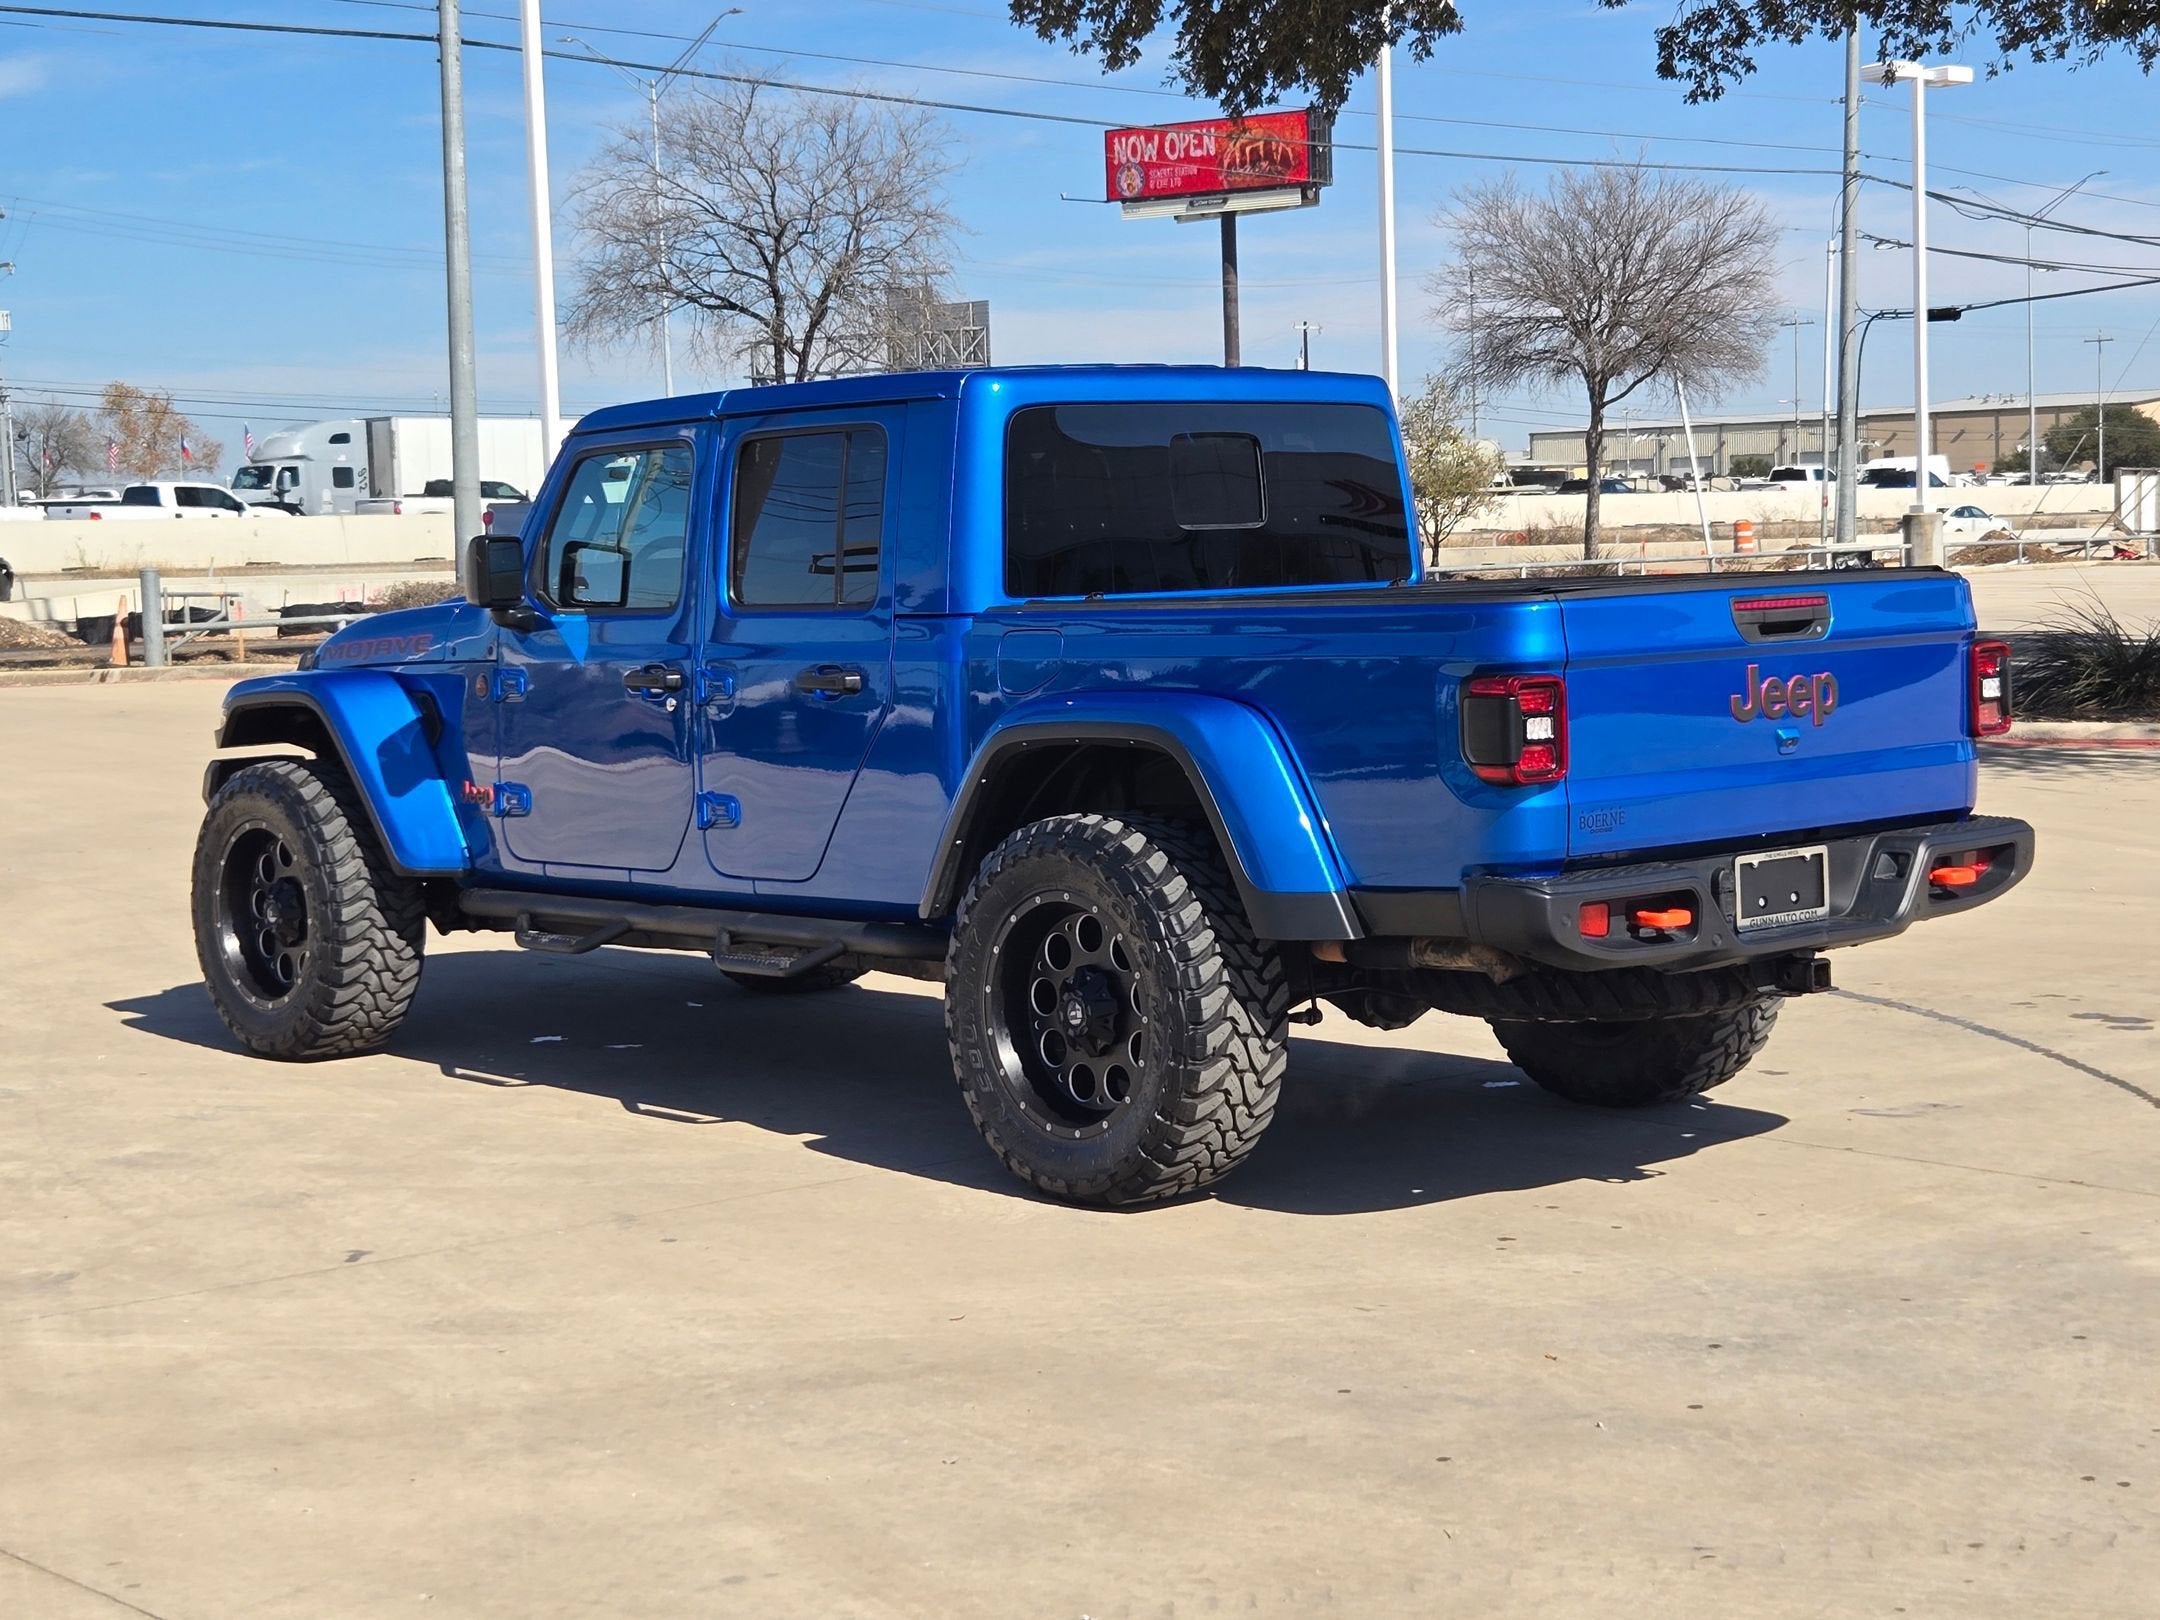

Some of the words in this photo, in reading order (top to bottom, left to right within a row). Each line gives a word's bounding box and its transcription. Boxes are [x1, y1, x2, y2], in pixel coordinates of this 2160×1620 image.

[1113, 134, 1159, 166] NOW
[1164, 127, 1217, 161] OPEN
[321, 633, 433, 661] MOJAVE
[1729, 664, 1839, 727] Jeep
[461, 780, 495, 809] Jeep
[1578, 810, 1626, 831] BOERNE
